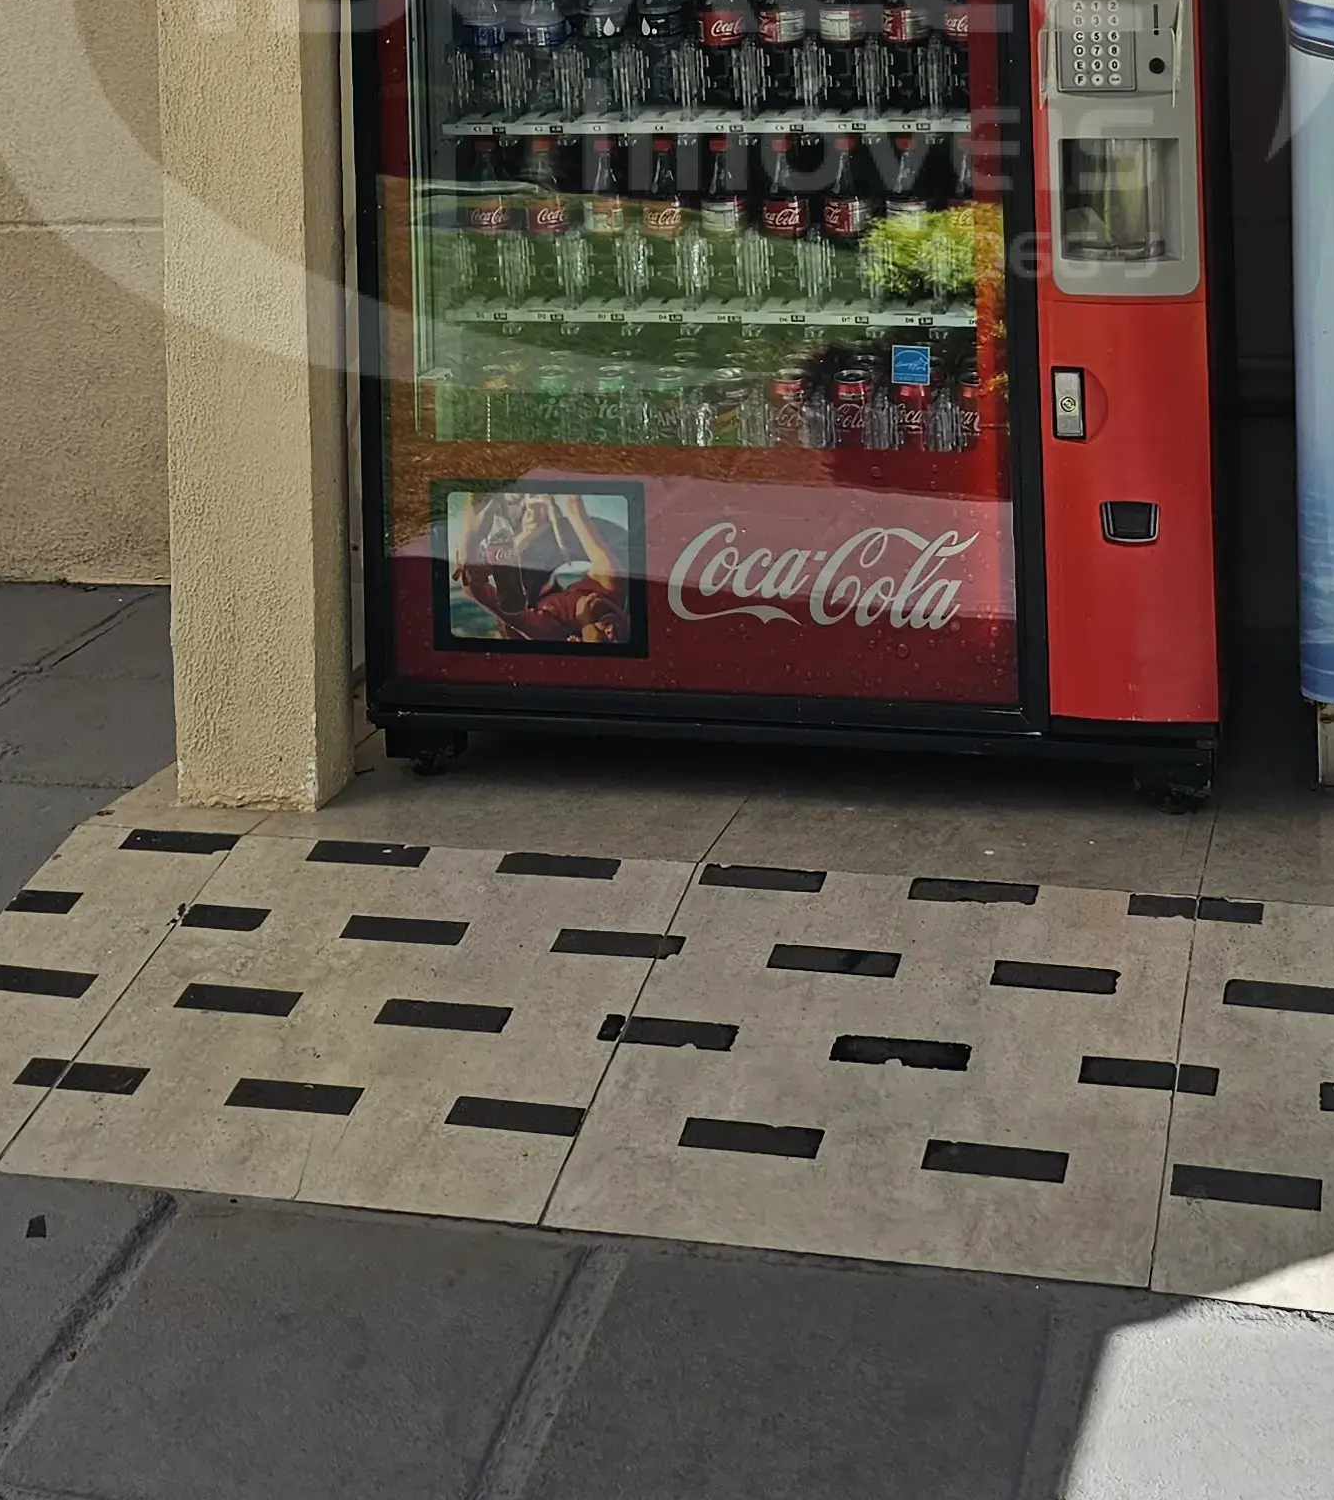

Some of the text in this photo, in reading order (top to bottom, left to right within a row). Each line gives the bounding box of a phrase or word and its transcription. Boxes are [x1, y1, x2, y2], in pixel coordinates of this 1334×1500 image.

[1076, 32, 1117, 41] C 5 6
[1076, 46, 1117, 55] D 7 8
[1076, 61, 1117, 70] E 9 0
[1077, 75, 1084, 84] F
[668, 522, 980, 630] Coca-Cola
